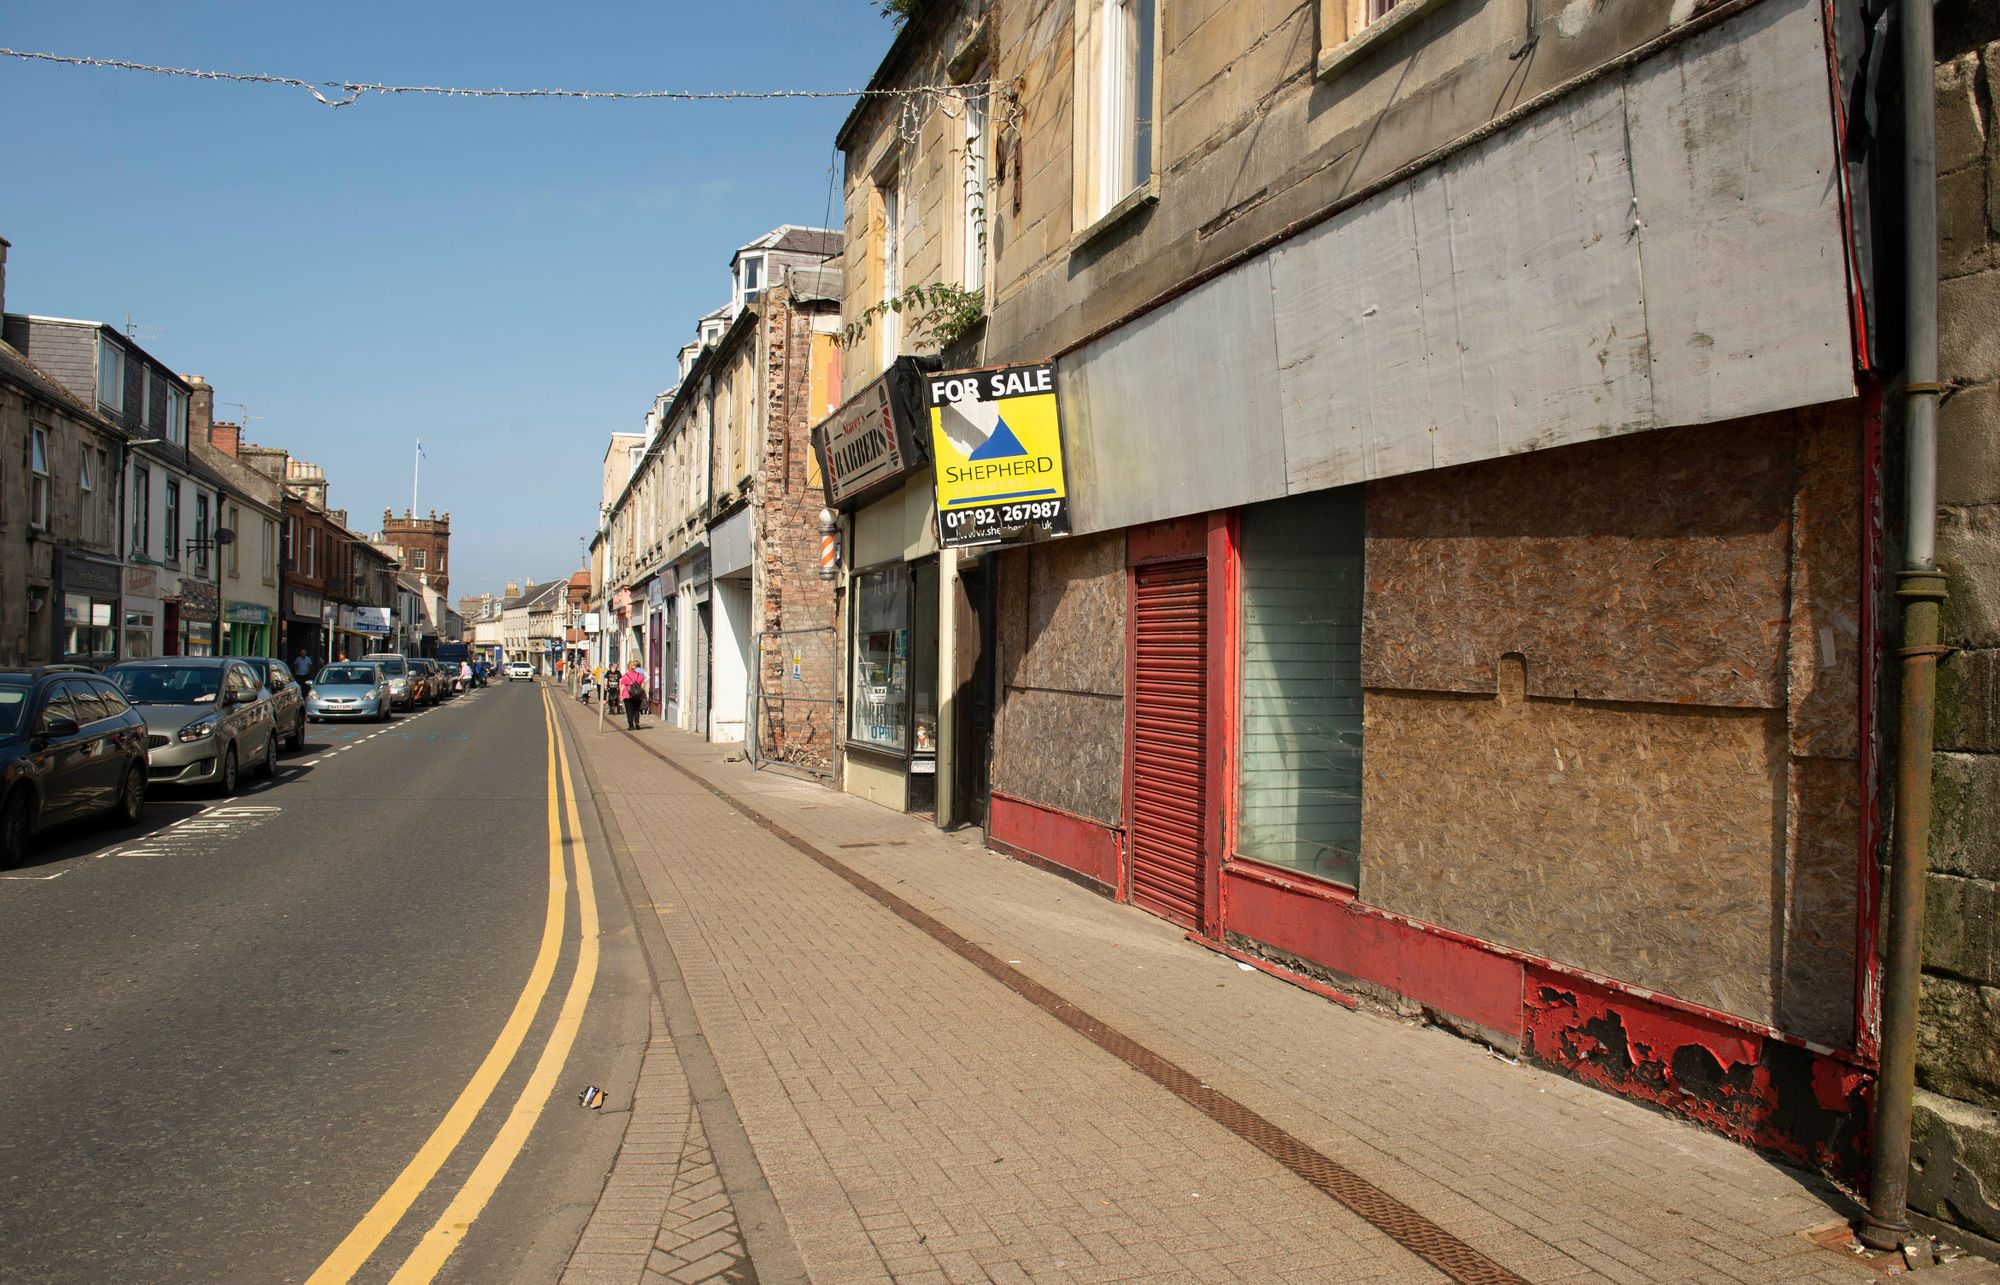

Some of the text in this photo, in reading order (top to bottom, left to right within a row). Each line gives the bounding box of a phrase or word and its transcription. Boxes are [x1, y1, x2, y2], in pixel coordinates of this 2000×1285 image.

[931, 369, 1053, 404] FOR SALE
[834, 424, 888, 479] BARBERS
[946, 456, 1053, 484] SHEPHERD
[1002, 501, 1061, 522] 267987
